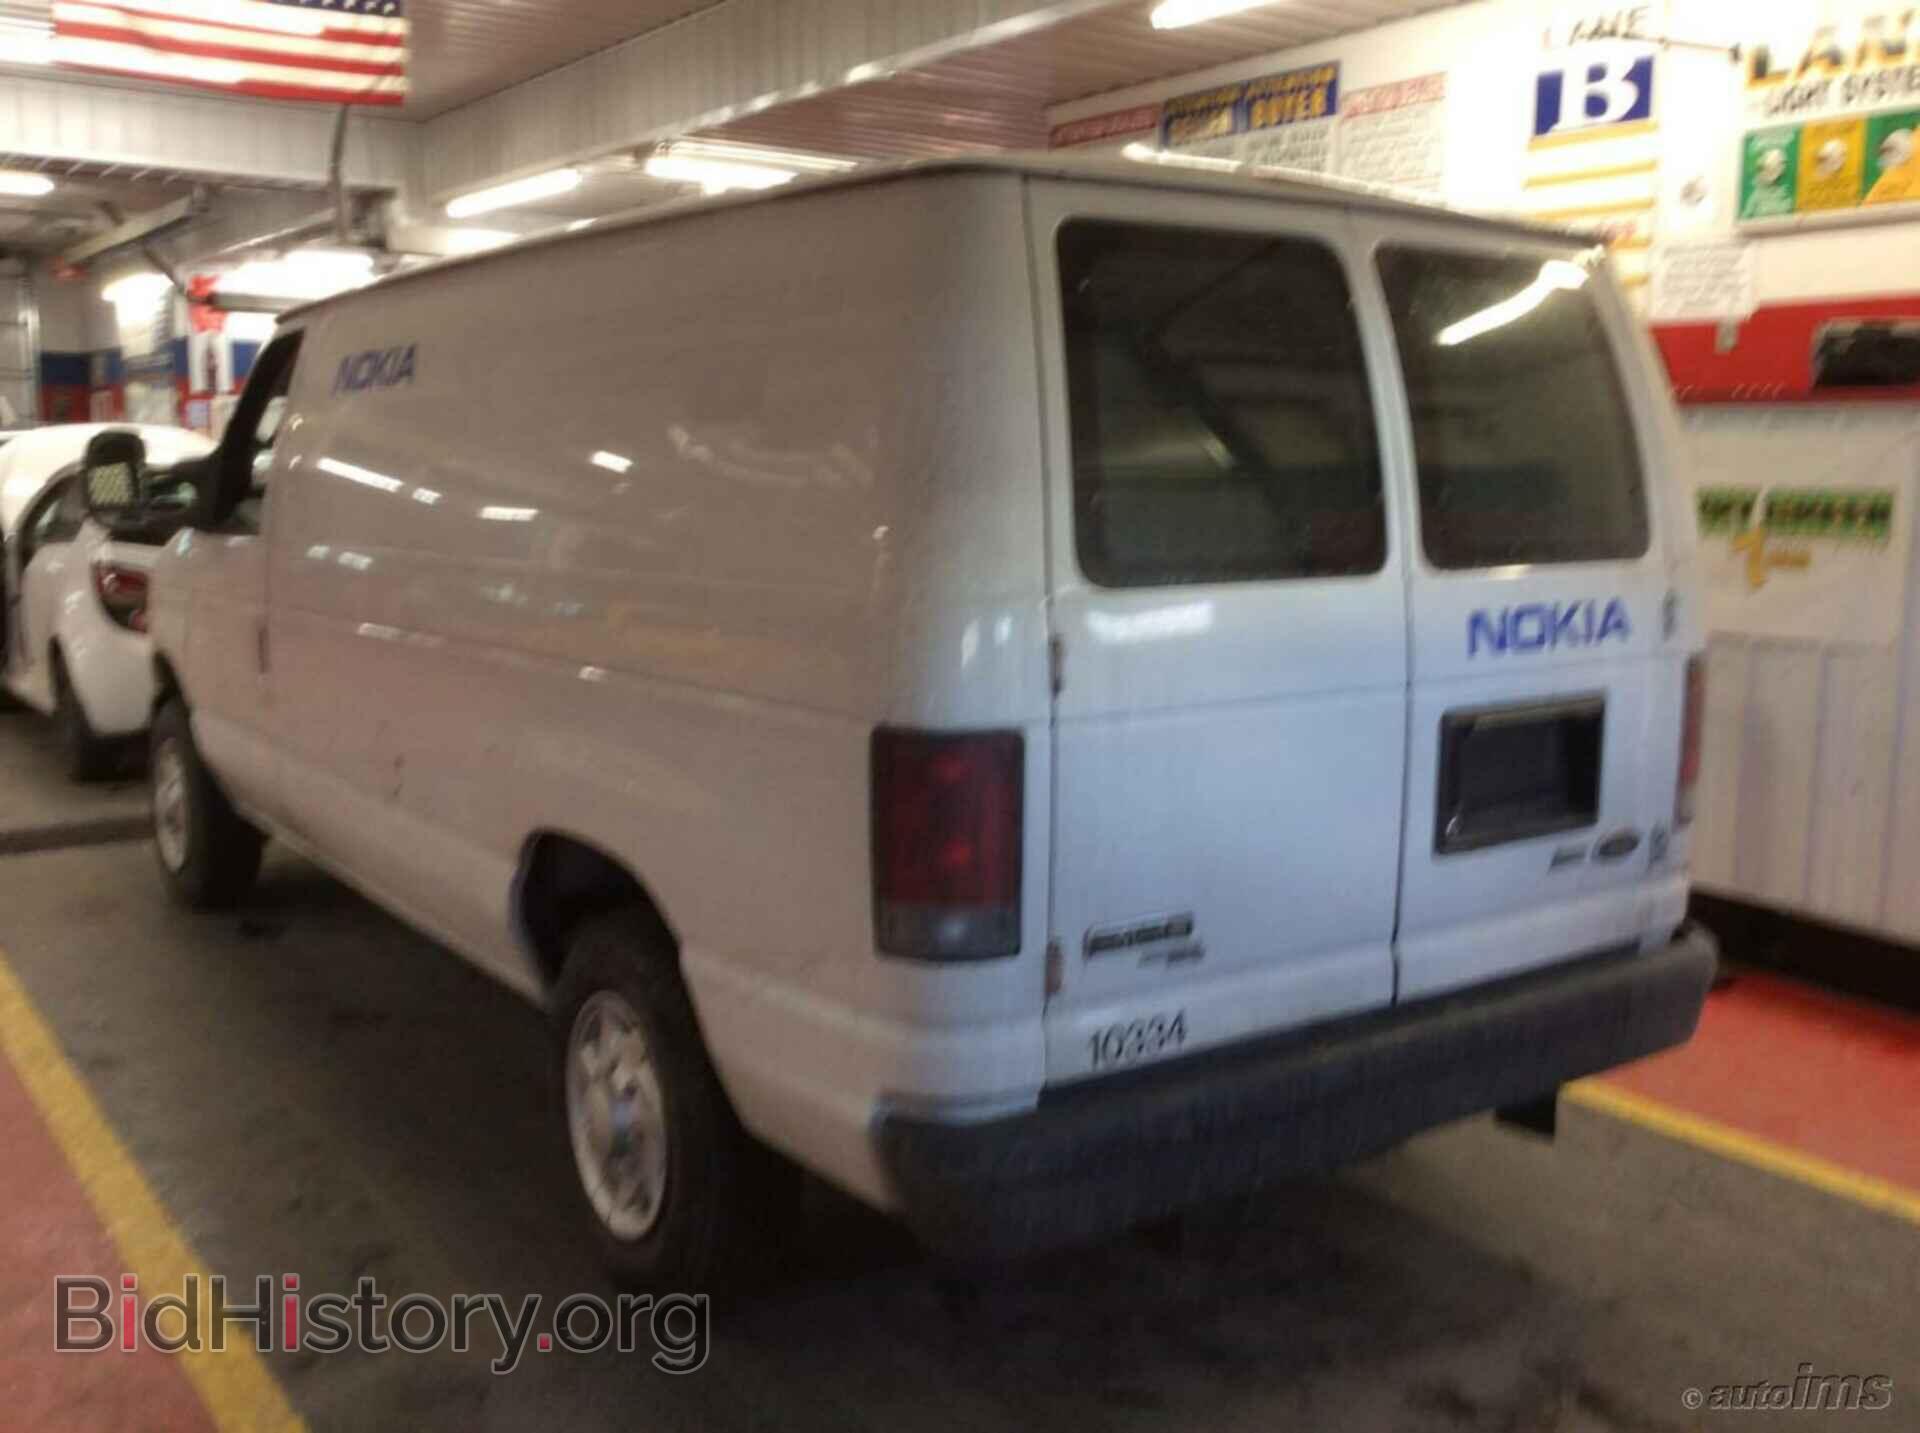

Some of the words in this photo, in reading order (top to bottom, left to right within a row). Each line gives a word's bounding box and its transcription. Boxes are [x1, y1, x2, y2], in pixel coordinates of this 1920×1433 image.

[332, 344, 417, 393] NOKIA
[1467, 596, 1630, 659] NOKIA
[1089, 1008, 1187, 1071] 10334
